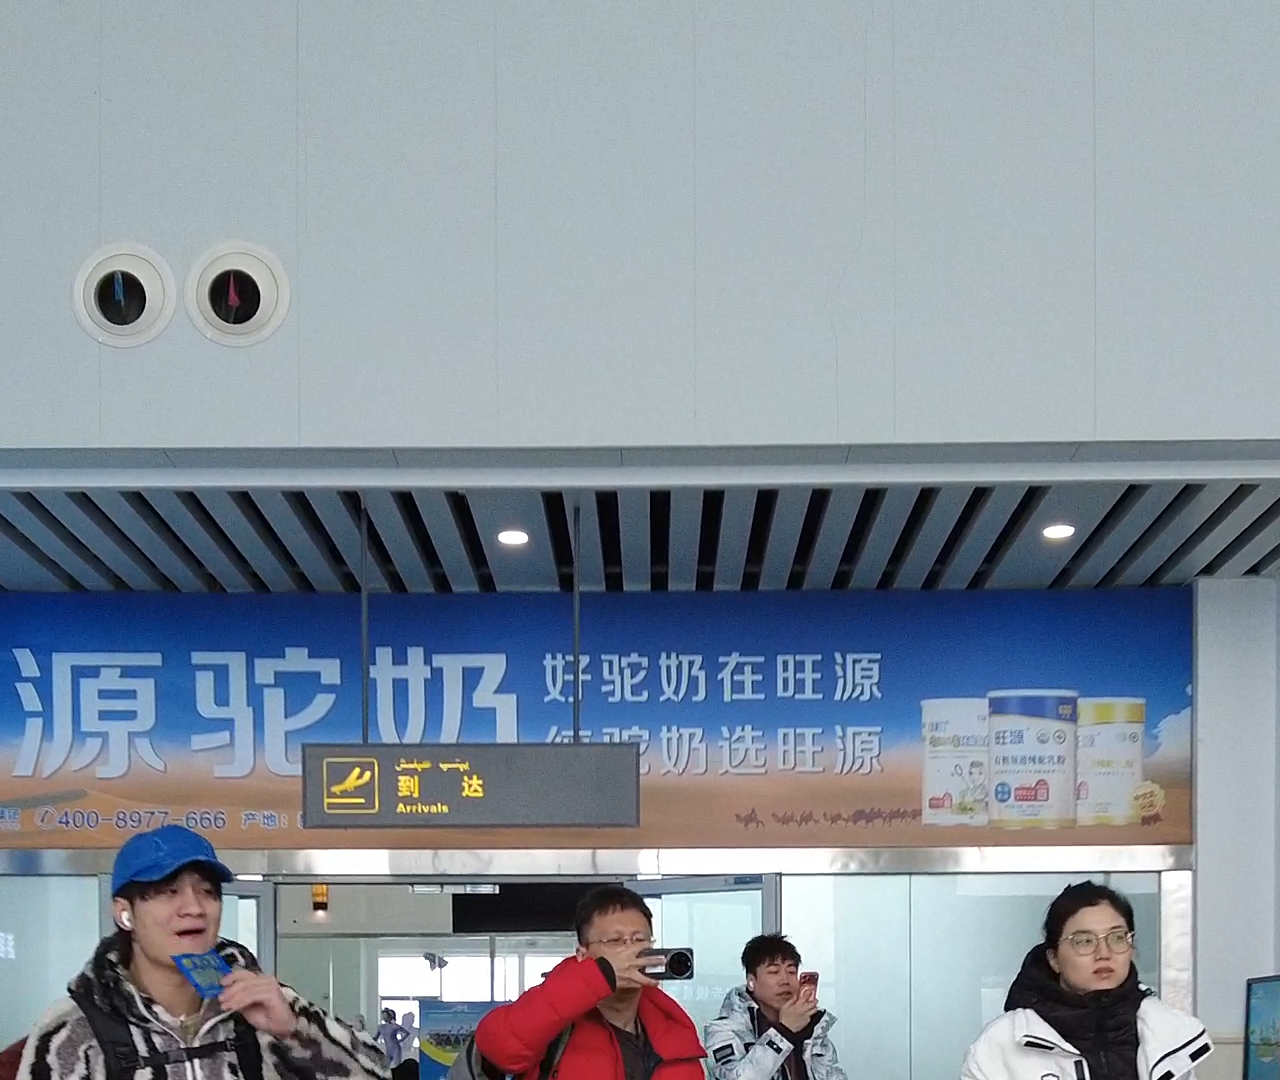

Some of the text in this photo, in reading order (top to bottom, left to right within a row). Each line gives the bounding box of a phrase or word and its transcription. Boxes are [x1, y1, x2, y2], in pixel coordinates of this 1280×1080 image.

[543, 651, 883, 703] 好驼奶在旺源
[395, 801, 449, 814] Arrivals
[241, 810, 304, 830] 产地：
